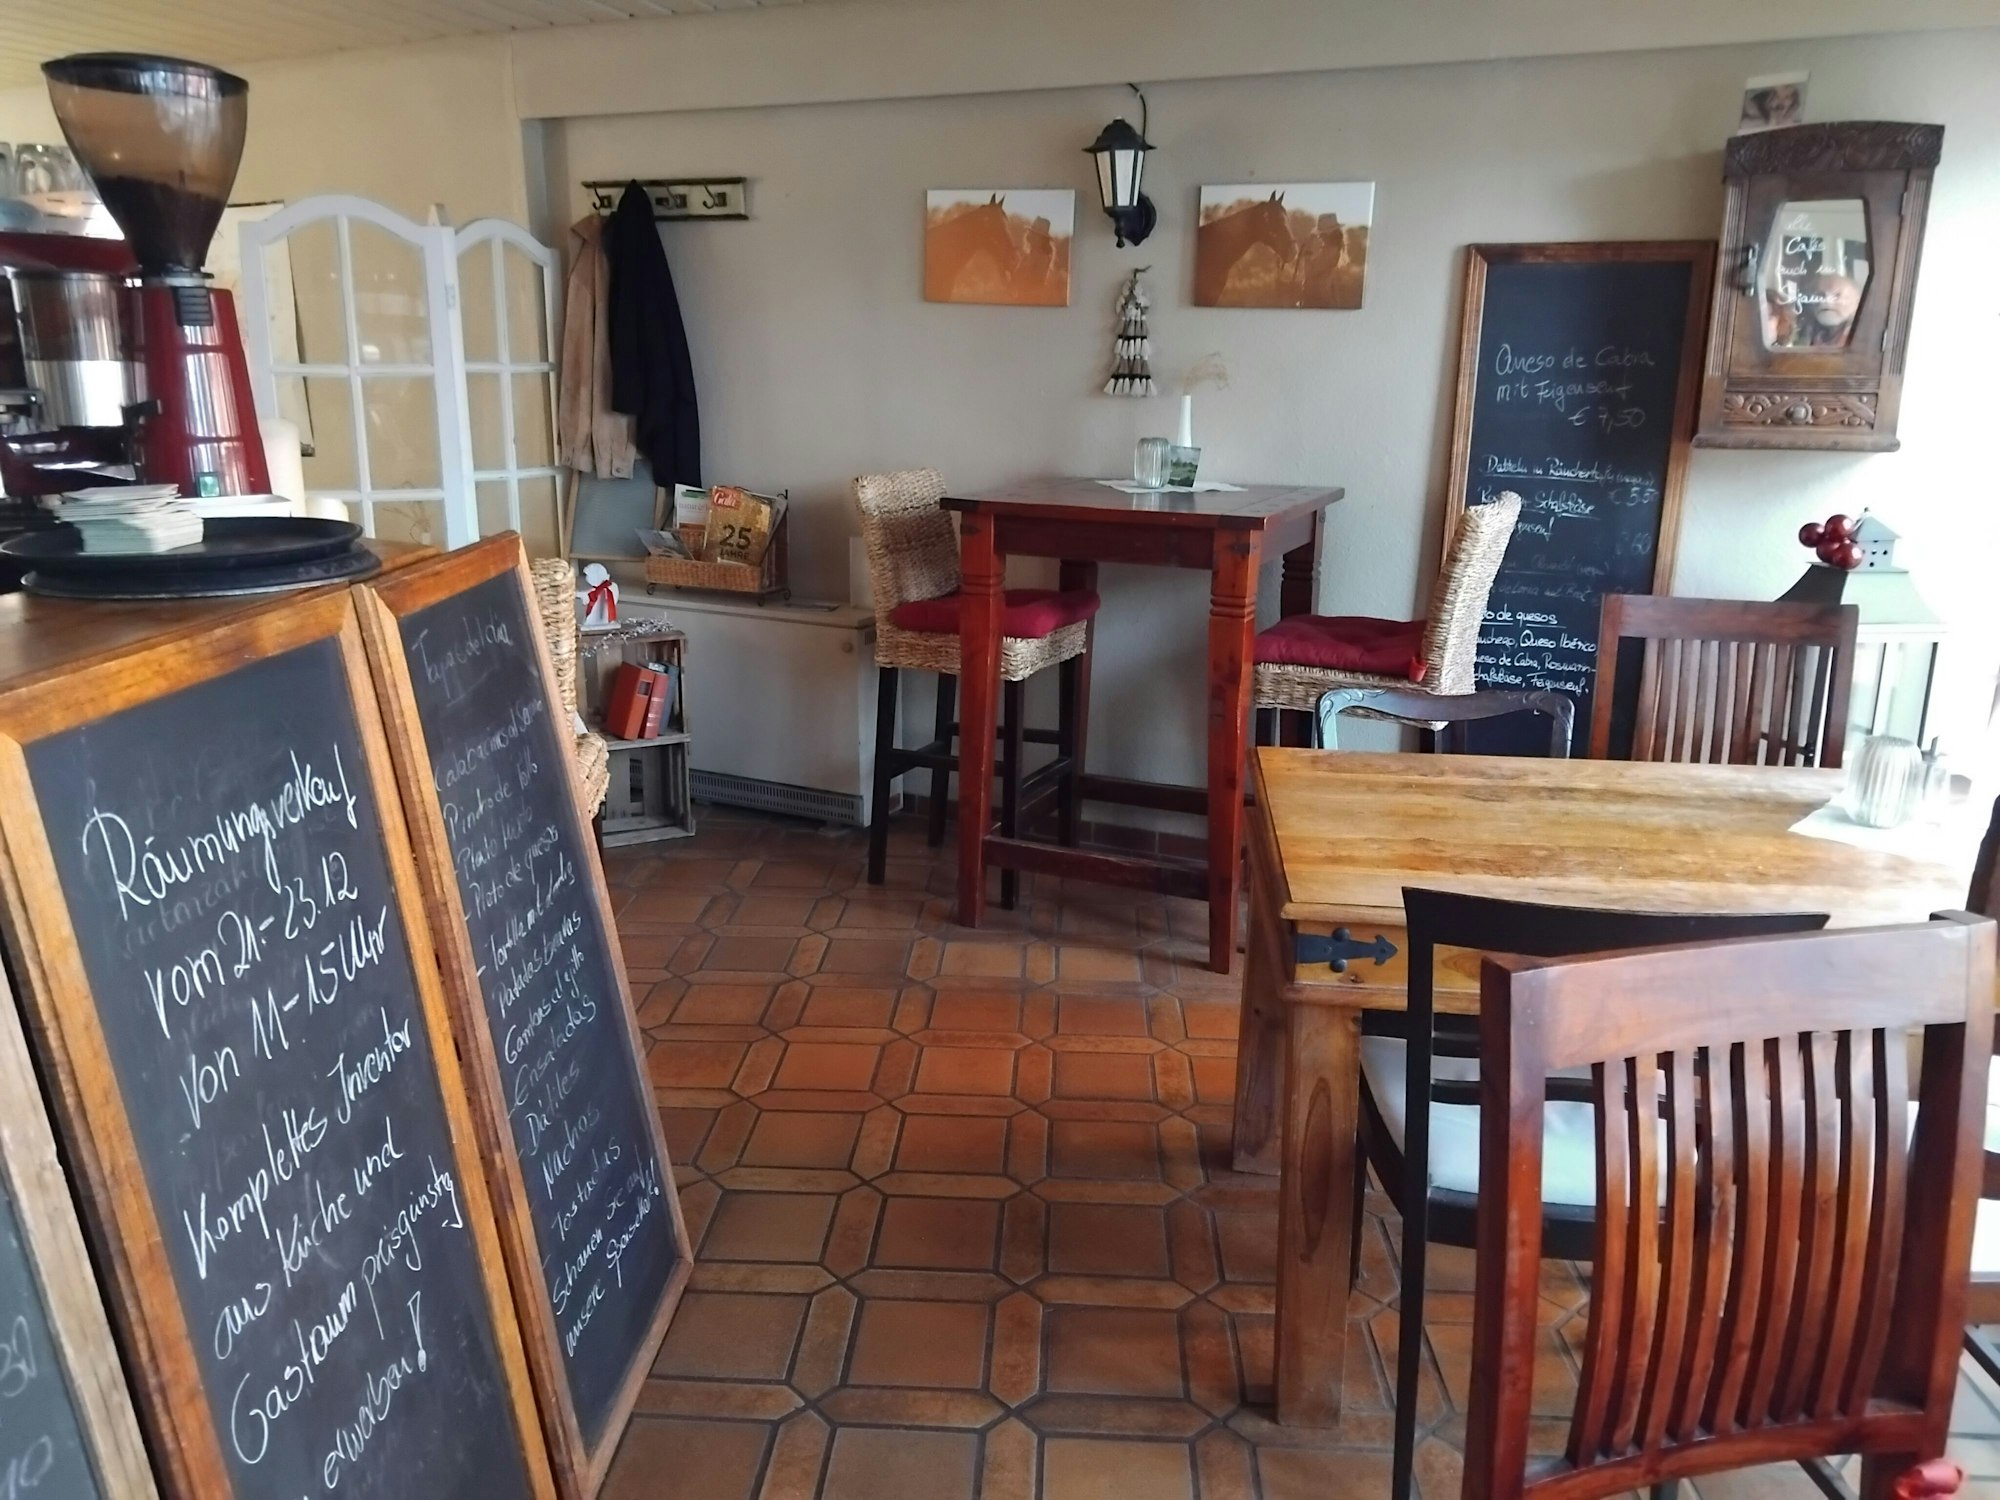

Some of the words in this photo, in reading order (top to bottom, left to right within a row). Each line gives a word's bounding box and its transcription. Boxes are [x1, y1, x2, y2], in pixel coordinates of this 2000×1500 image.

[1496, 344, 1555, 375] Queso
[1563, 347, 1588, 368] de
[1497, 376, 1529, 402] mit
[1568, 407, 1590, 426] €
[1486, 454, 1528, 474] Datteln
[1534, 489, 1596, 516] Schafskäse
[719, 524, 752, 549] 25
[719, 548, 750, 560] JAHRE
[1496, 603, 1514, 621] de
[1516, 611, 1558, 628] quesos
[1520, 629, 1557, 649] Queso
[1498, 649, 1512, 667] de
[469, 878, 504, 921] Plato
[505, 853, 523, 888] de
[145, 948, 225, 1040] vom
[179, 1046, 241, 1130] von
[338, 905, 388, 983] Uhr
[504, 997, 553, 1065] Gambas
[514, 994, 597, 1107] Ensaladas
[542, 1100, 601, 1201] Nachos
[214, 1282, 272, 1360] aus
[354, 1116, 404, 1196] und
[552, 1226, 604, 1317] Schauen
